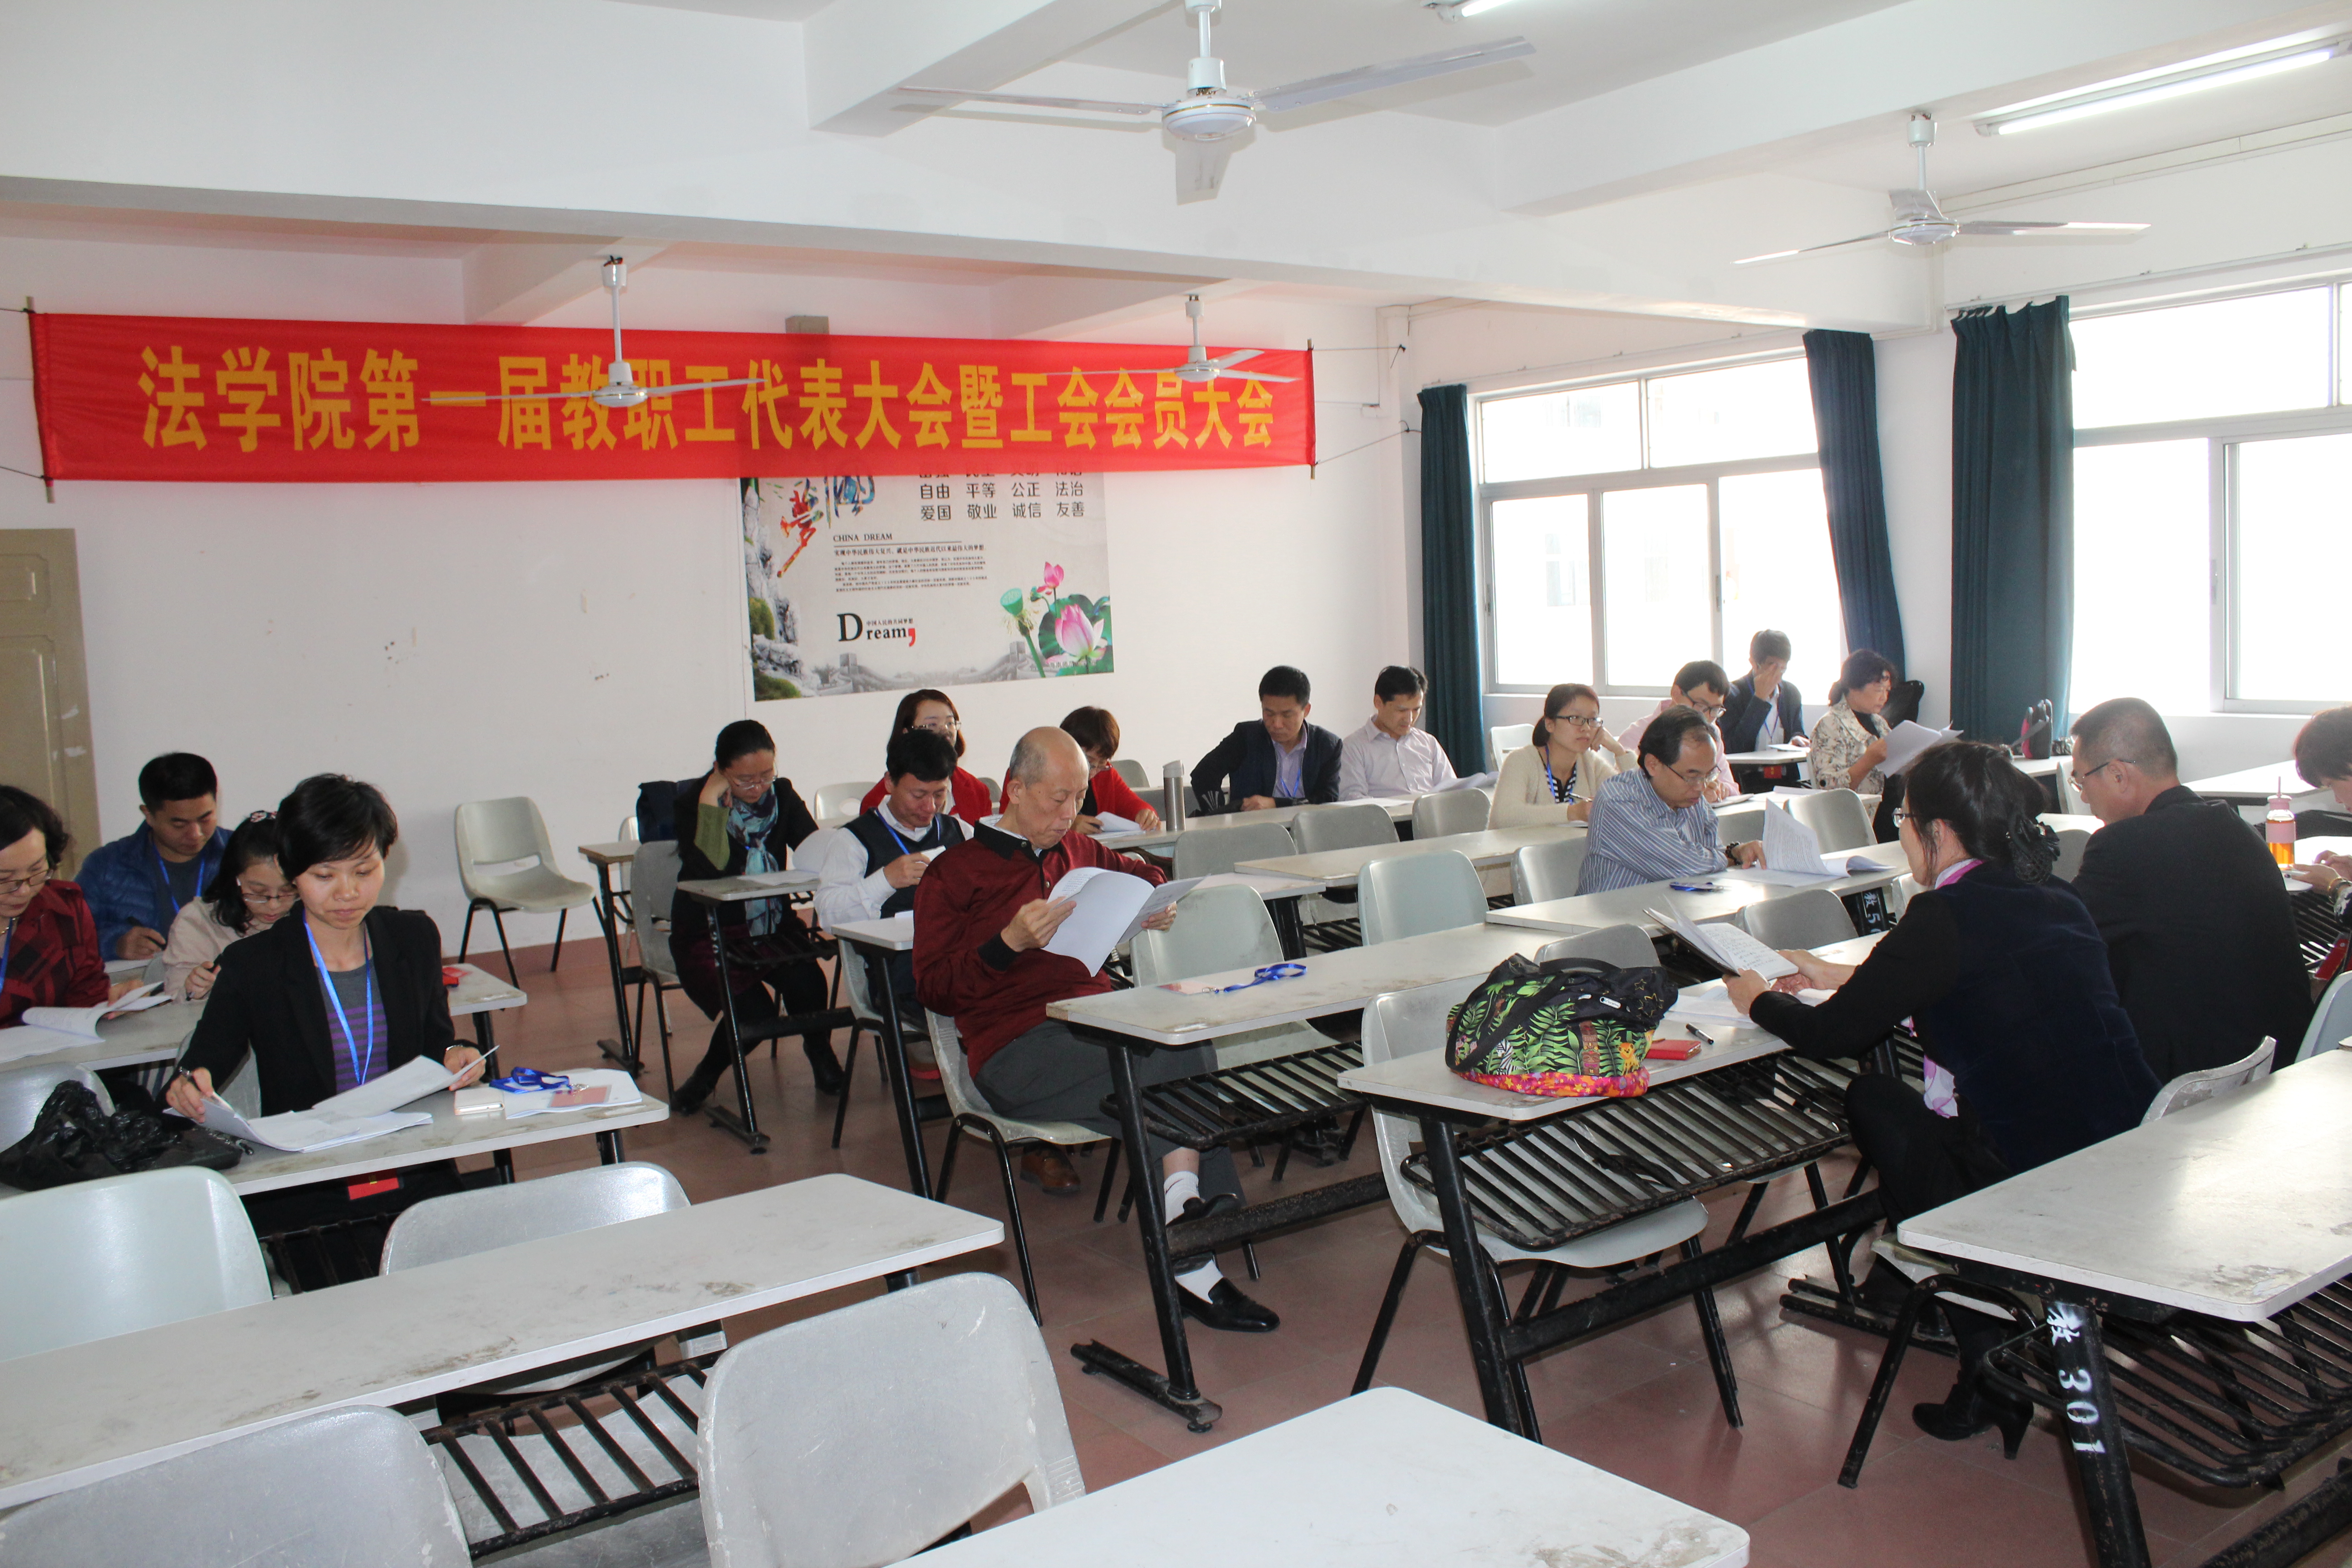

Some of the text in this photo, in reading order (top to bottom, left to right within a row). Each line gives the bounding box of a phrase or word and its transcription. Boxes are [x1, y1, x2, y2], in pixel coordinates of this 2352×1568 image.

[138, 346, 1274, 452] 法学院第一届教职工代表大会暨工会会员大会
[920, 480, 1083, 499] 自由 平等 公正 法治
[921, 501, 1085, 521] 爱国 敬业 诚信 友善
[833, 532, 893, 542] CHINA DREAM
